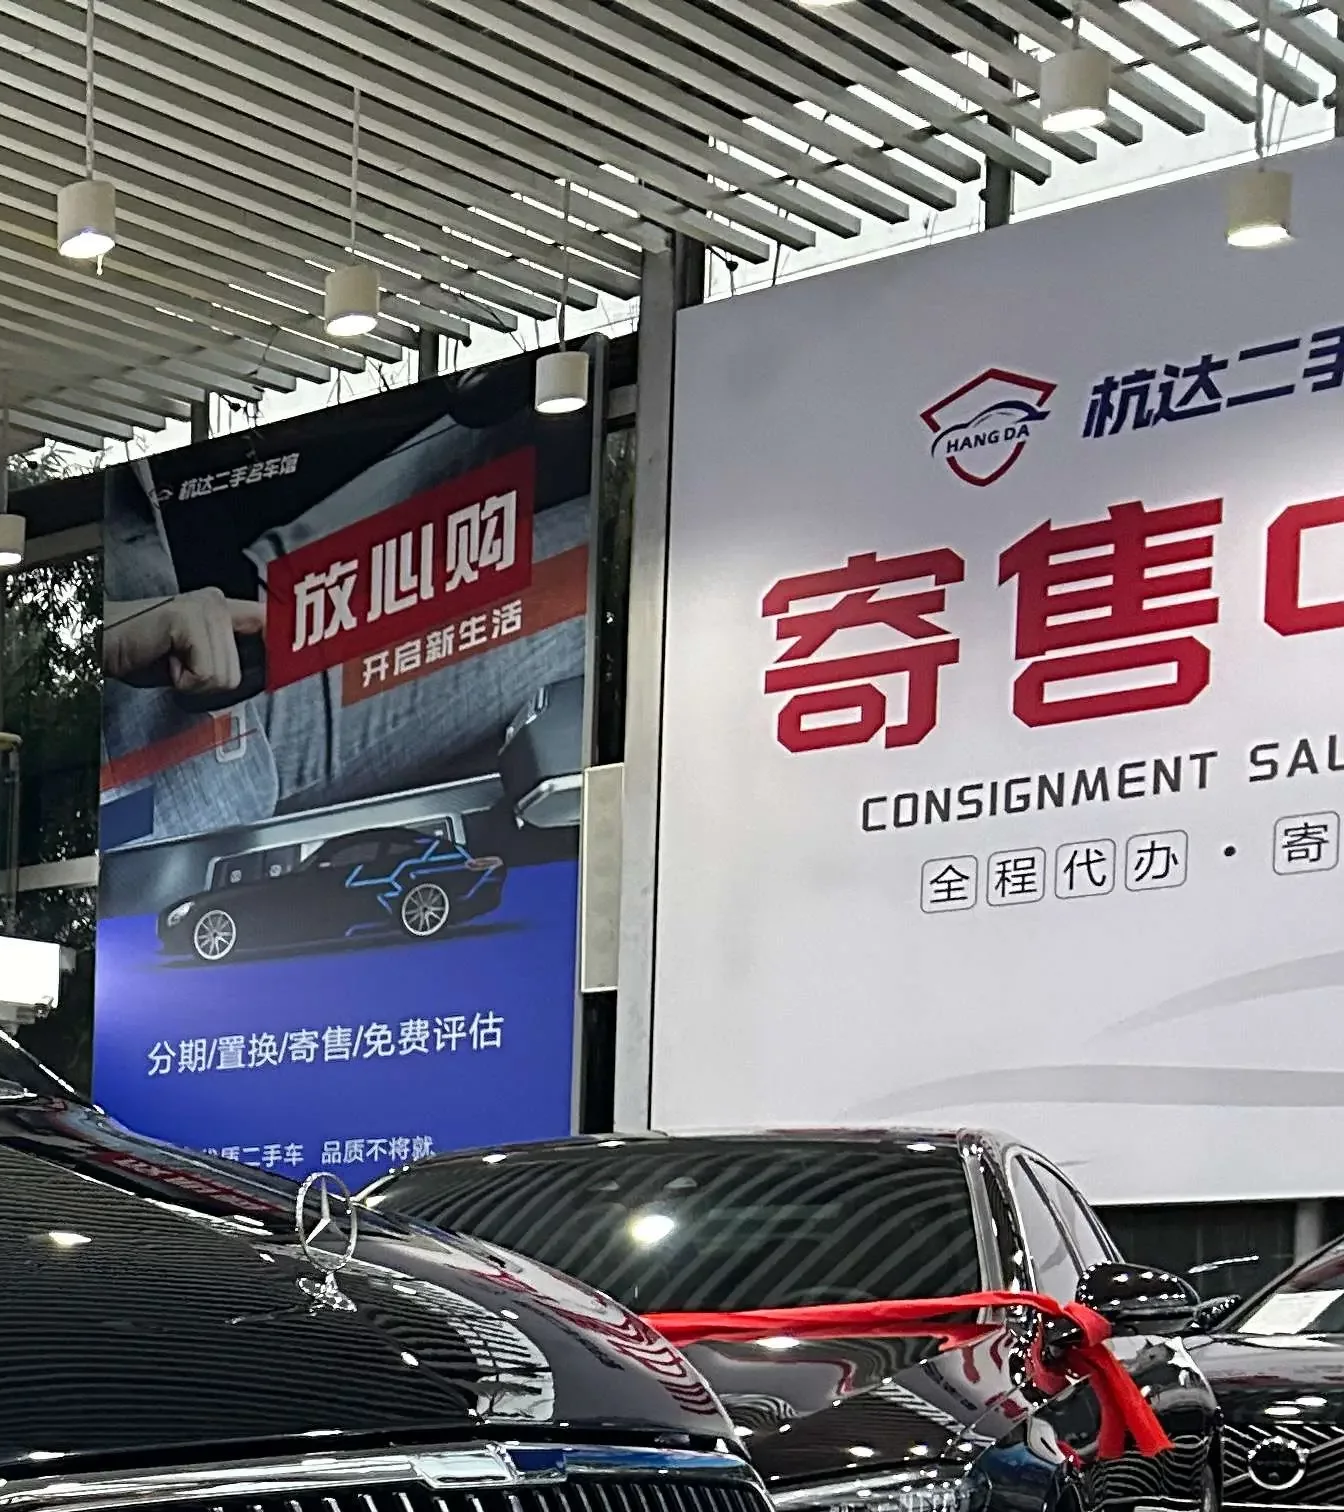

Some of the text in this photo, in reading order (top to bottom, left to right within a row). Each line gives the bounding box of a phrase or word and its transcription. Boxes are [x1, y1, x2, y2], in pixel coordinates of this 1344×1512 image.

[946, 423, 1030, 455] HANG DA
[178, 453, 300, 501] 杭达二手名车馆
[291, 489, 518, 653] 放心购
[361, 600, 524, 688] 开启新生活
[861, 750, 1219, 832] CONSIGNMENT
[146, 1010, 505, 1077] 分期/置换/寄售/免费评估
[321, 1135, 436, 1166] 品质不将就
